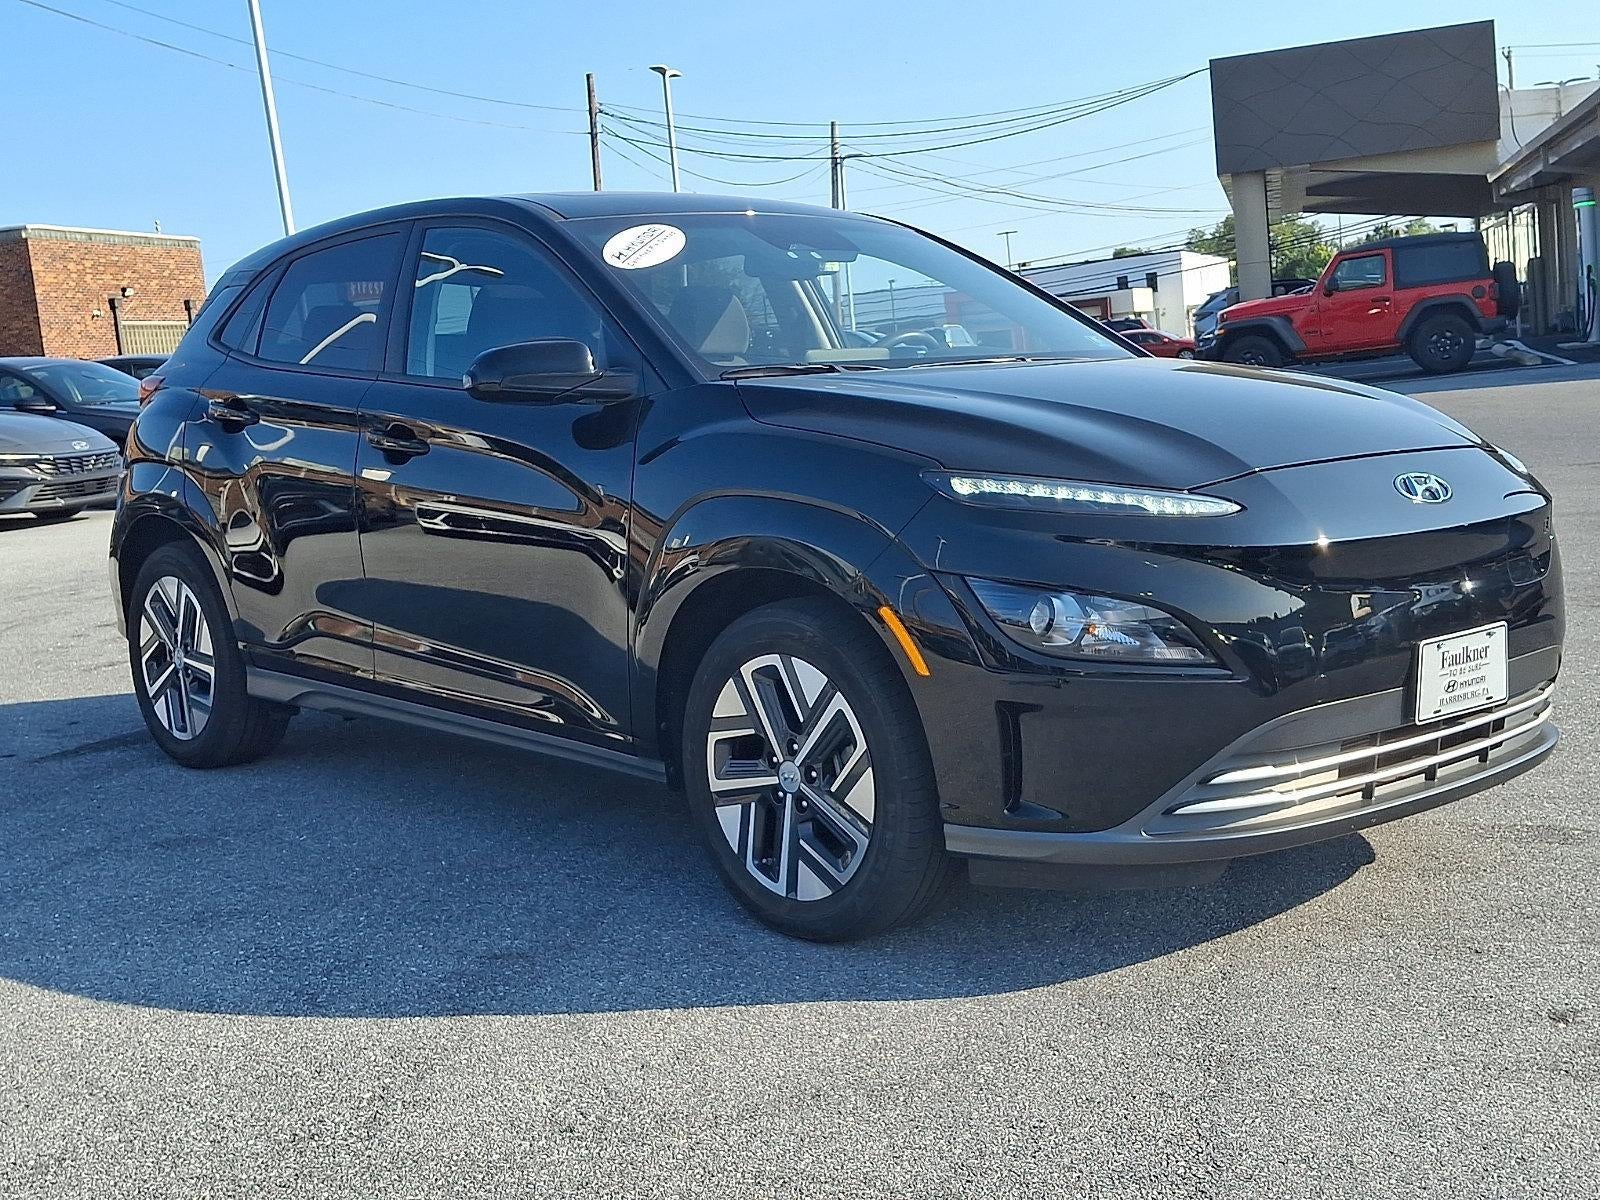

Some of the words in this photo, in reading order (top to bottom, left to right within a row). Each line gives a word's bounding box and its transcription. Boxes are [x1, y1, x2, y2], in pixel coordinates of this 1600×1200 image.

[1441, 646, 1489, 670] Faulkner
[1449, 669, 1457, 677] TO
[1459, 675, 1486, 688] HYUNDAI
